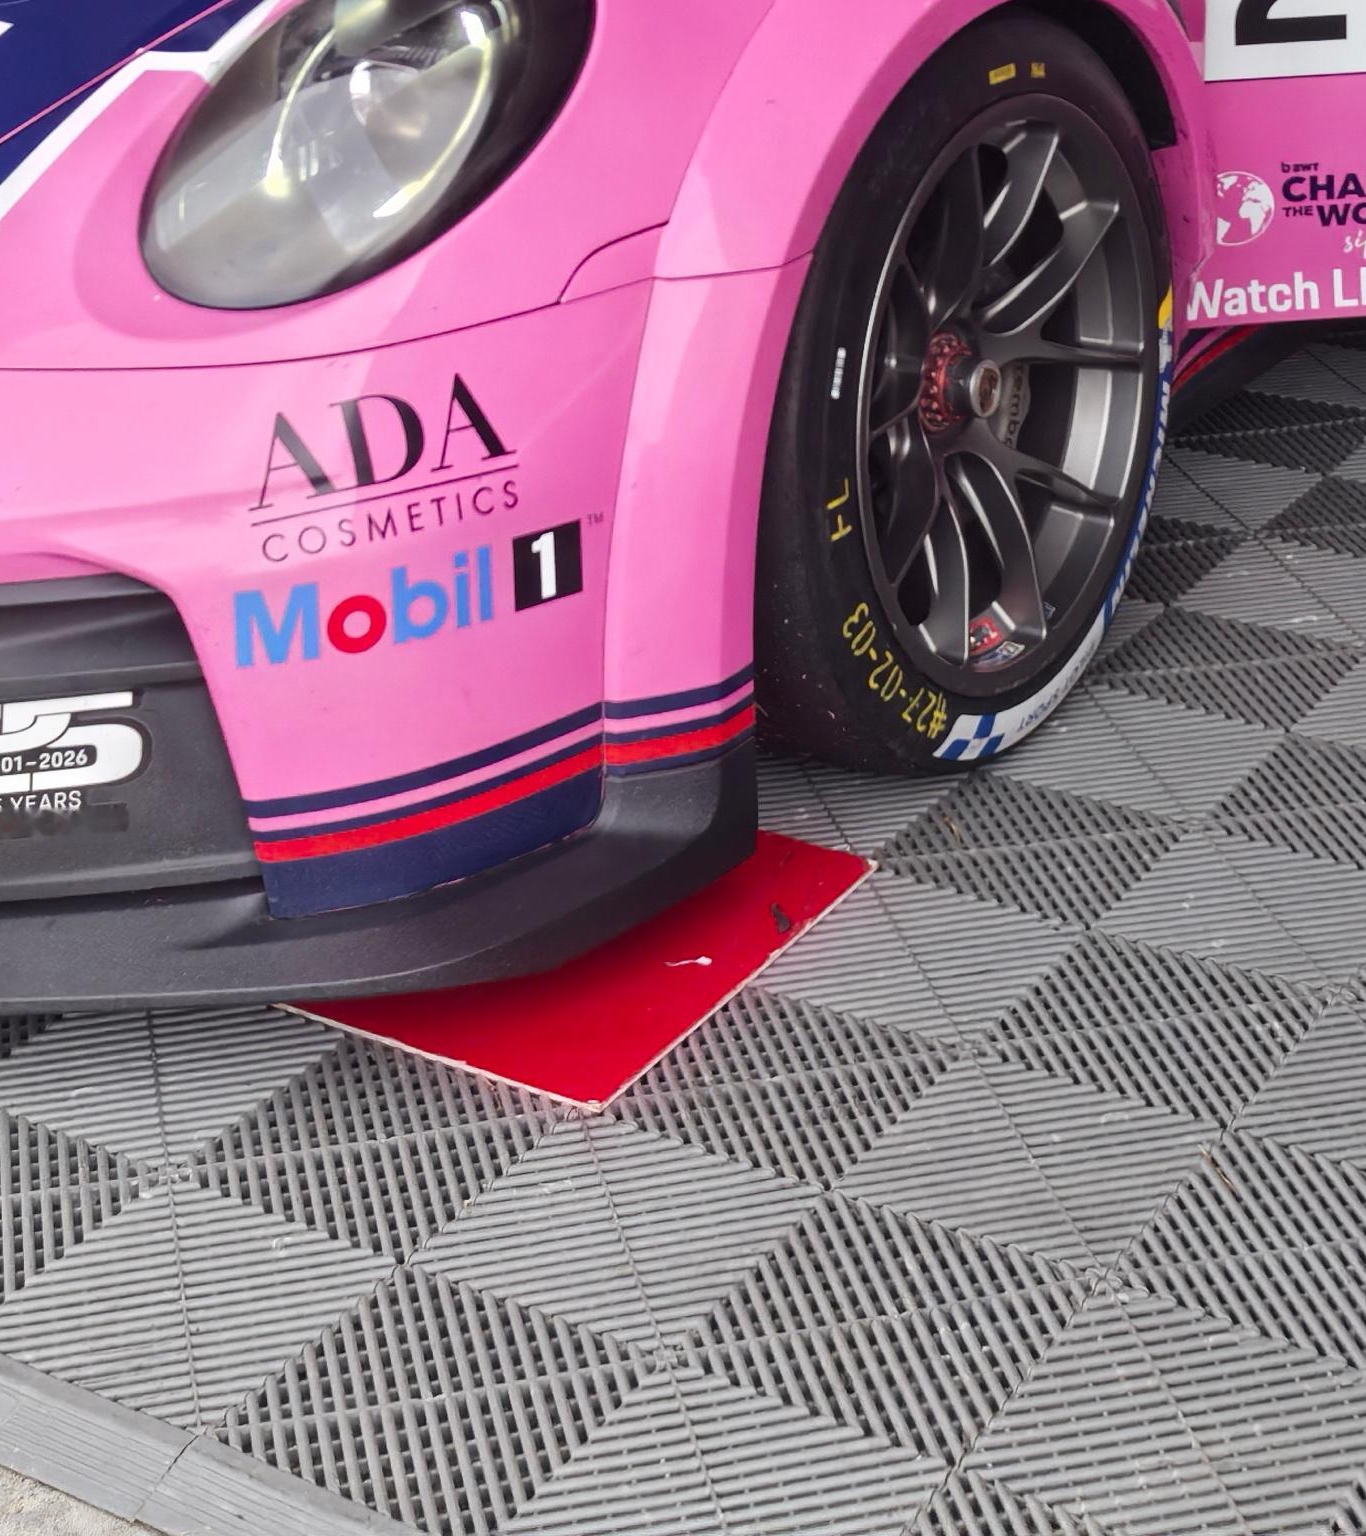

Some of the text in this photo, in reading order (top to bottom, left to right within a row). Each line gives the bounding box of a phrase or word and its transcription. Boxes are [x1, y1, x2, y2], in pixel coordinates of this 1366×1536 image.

[1282, 205, 1313, 218] THE
[1187, 268, 1320, 322] Watch
[248, 372, 518, 512] ADA
[261, 480, 519, 563] COSMETICS
[233, 544, 494, 669] Mobil
[10, 790, 83, 810] YEARS
